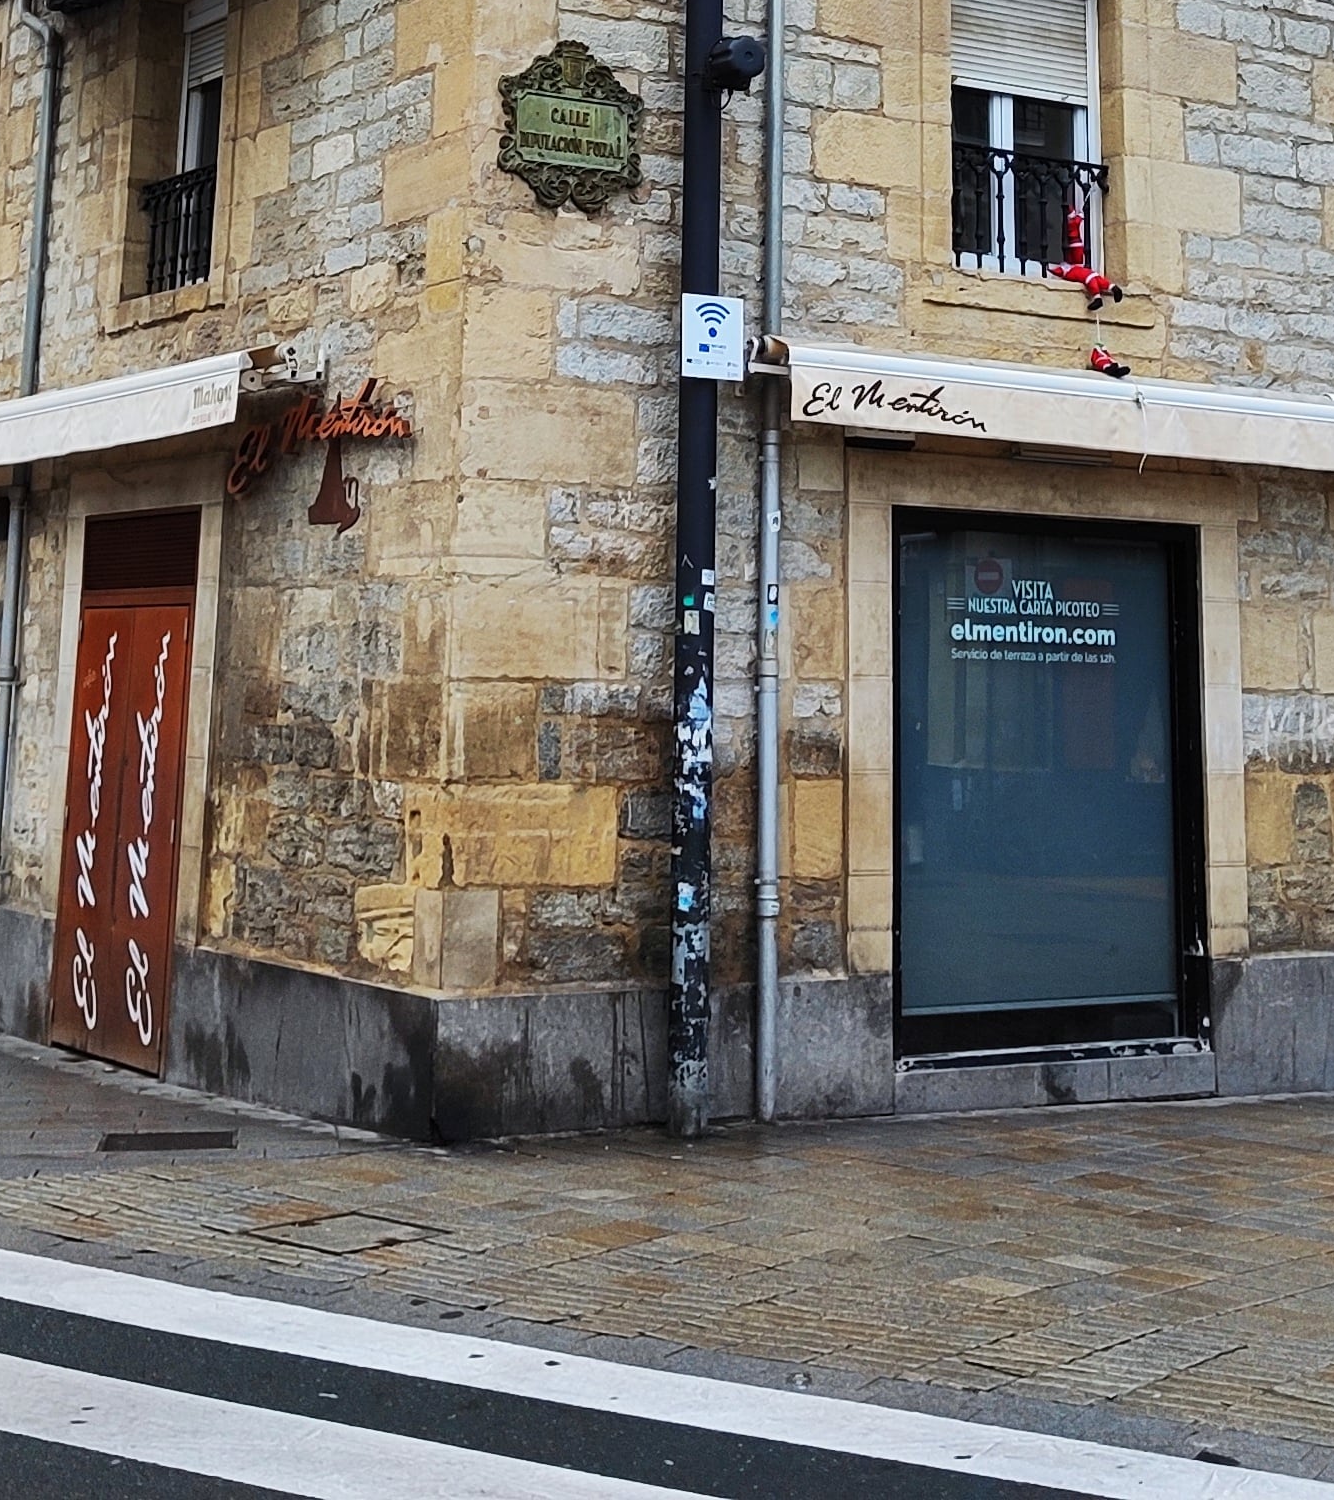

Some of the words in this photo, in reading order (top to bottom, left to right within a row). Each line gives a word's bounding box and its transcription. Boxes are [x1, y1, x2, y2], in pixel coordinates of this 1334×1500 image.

[551, 107, 590, 128] CALLE
[519, 128, 582, 155] DIPUTACIÓN
[802, 382, 842, 417] El
[851, 379, 987, 433] Mentirón
[227, 426, 271, 494] El
[1012, 579, 1054, 600] VISITA
[968, 597, 1017, 615] NUESTRA
[1019, 600, 1053, 616] CARTA
[1055, 601, 1100, 618] PICOTEO
[950, 618, 1116, 646] elmentiron.com
[951, 647, 988, 660] Servicio
[990, 649, 1003, 660] de
[1004, 650, 1036, 662] terraza
[1037, 652, 1044, 661] a
[1045, 651, 1070, 664] partir
[1071, 652, 1083, 662] de
[1084, 651, 1098, 663] las
[73, 926, 97, 1031] El
[125, 937, 153, 1046] El
